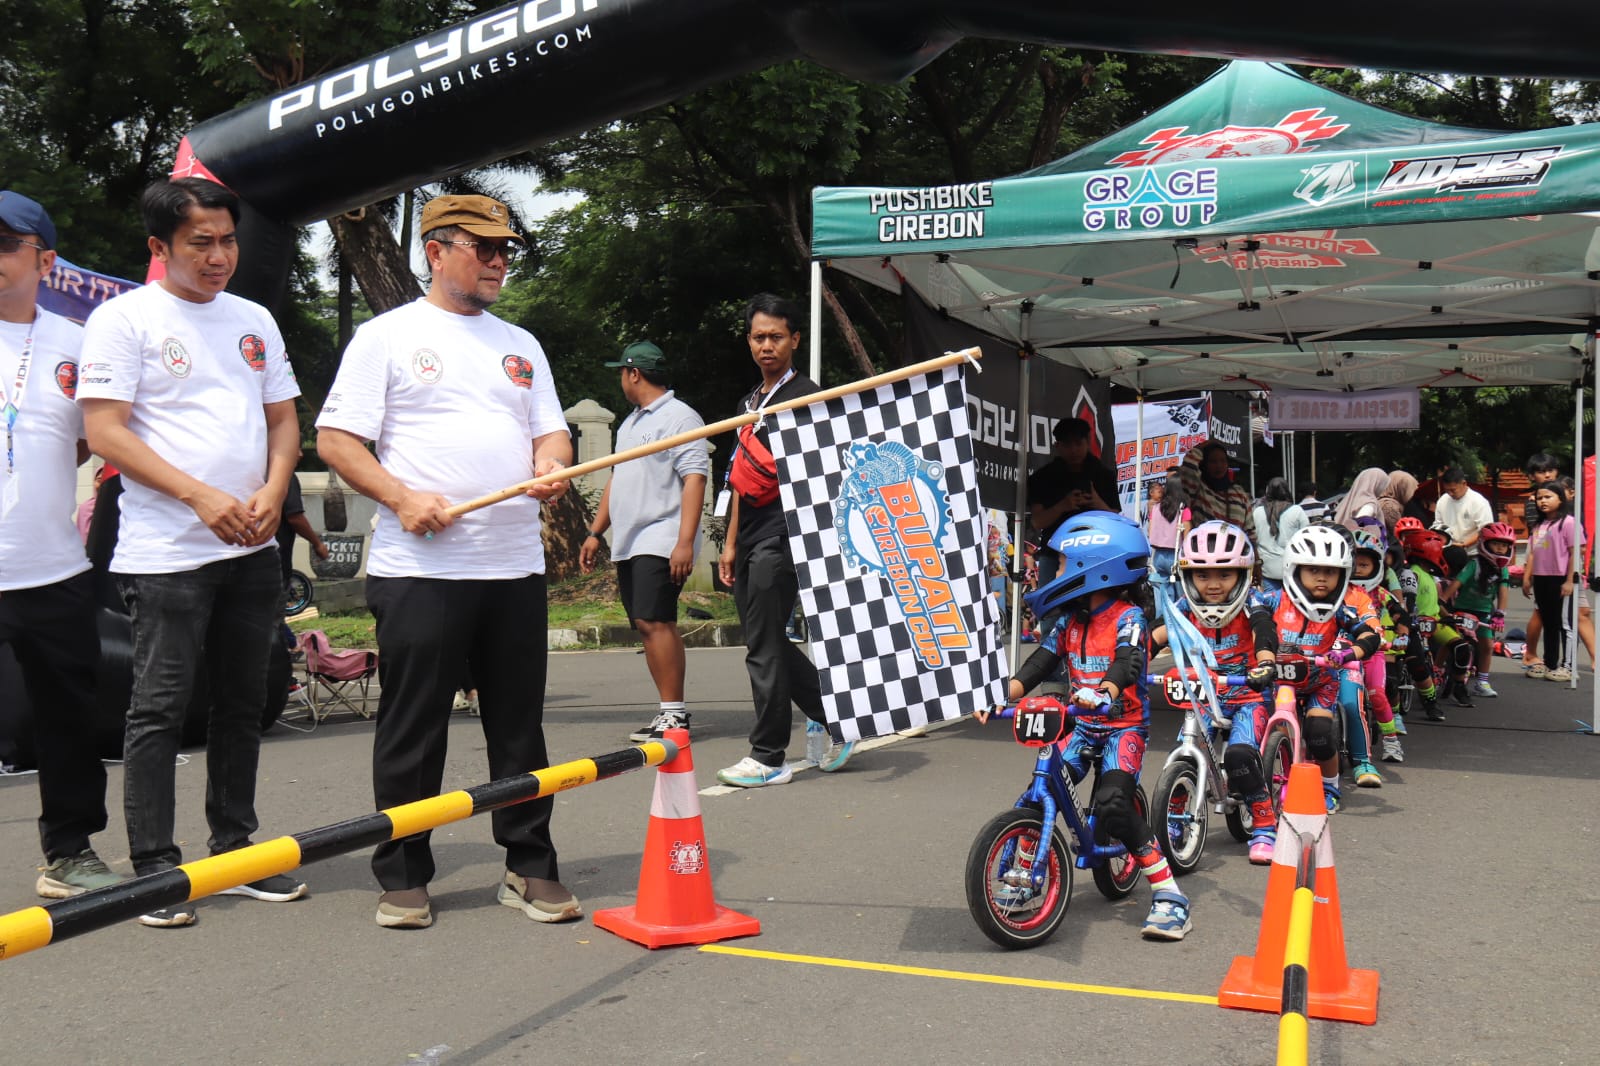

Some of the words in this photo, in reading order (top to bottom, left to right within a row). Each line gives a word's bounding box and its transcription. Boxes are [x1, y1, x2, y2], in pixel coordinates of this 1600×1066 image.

[269, 0, 598, 131] POLYGO
[315, 24, 593, 138] POLYGONBIKES.COM
[1083, 168, 1218, 202] GRAGE
[879, 211, 984, 242] CIREBON
[1083, 203, 1218, 230] GROUP
[1210, 416, 1241, 445] POLYGON
[328, 553, 358, 563] 2016
[1060, 534, 1111, 551] PRO
[878, 480, 972, 649] BUPATI
[864, 504, 926, 615] CIREBON
[907, 615, 944, 668] CUP
[1172, 680, 1206, 701] 327
[1025, 713, 1046, 737] 74
[1061, 764, 1089, 829] STRIDER
